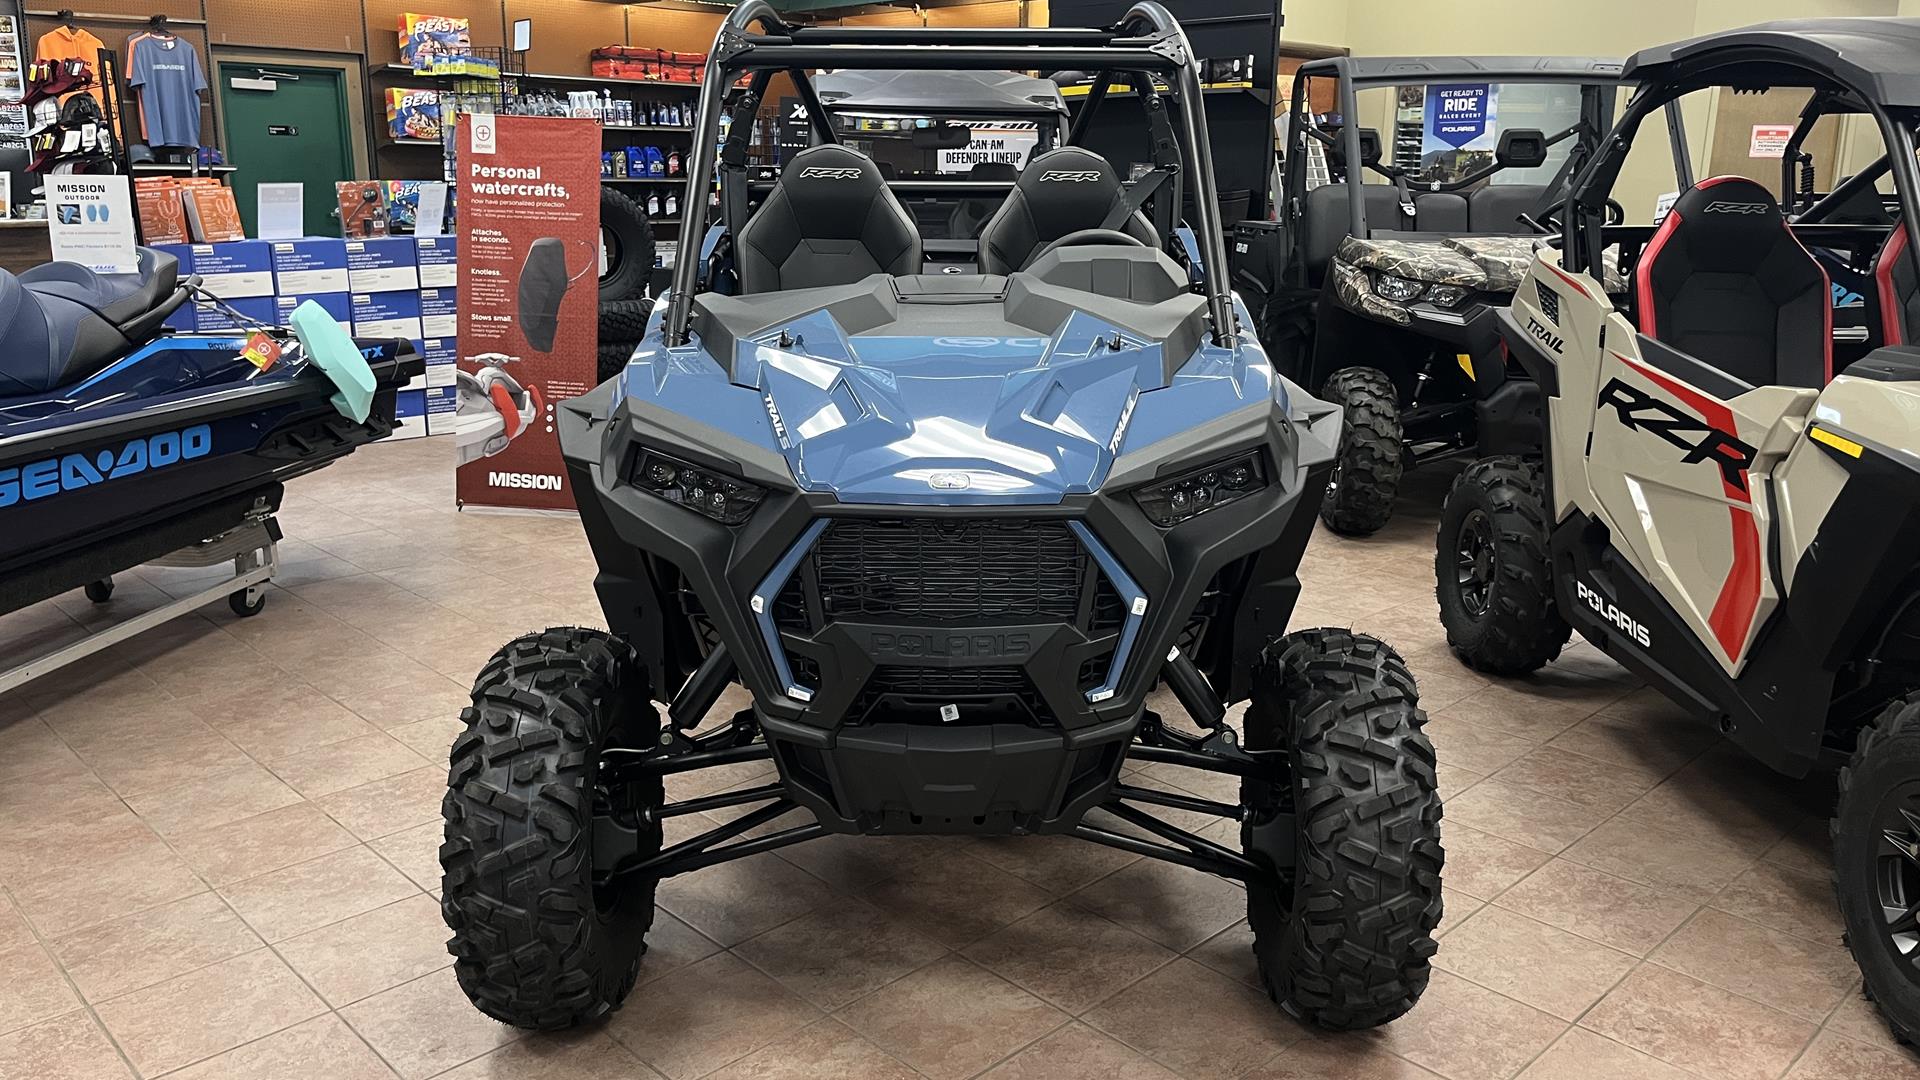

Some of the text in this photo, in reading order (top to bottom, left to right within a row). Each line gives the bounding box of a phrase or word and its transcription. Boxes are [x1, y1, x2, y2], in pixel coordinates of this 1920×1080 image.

[1440, 90, 1452, 98] GET
[1444, 97, 1478, 113] RIDE
[969, 140, 1004, 150] CAN-AM
[945, 152, 1022, 164] DEFENDER LINEUP
[471, 163, 541, 180] Personal
[800, 167, 862, 179] RZR
[1040, 170, 1101, 183] RZR
[57, 184, 106, 193] MISSION
[471, 182, 570, 200] watercrafts,
[499, 200, 535, 208] personalized
[1704, 201, 1768, 214] RZR
[471, 228, 502, 236] Attaches
[479, 236, 511, 244] seconds.
[471, 313, 492, 321] Stows
[1526, 316, 1564, 355] TRAIL
[361, 346, 384, 358] TX
[764, 392, 785, 438] TRAIL
[1598, 376, 1758, 496] RZR
[488, 471, 562, 491] MISSION
[1577, 580, 1651, 648] POLARIS
[870, 632, 1032, 657] POLARIS
